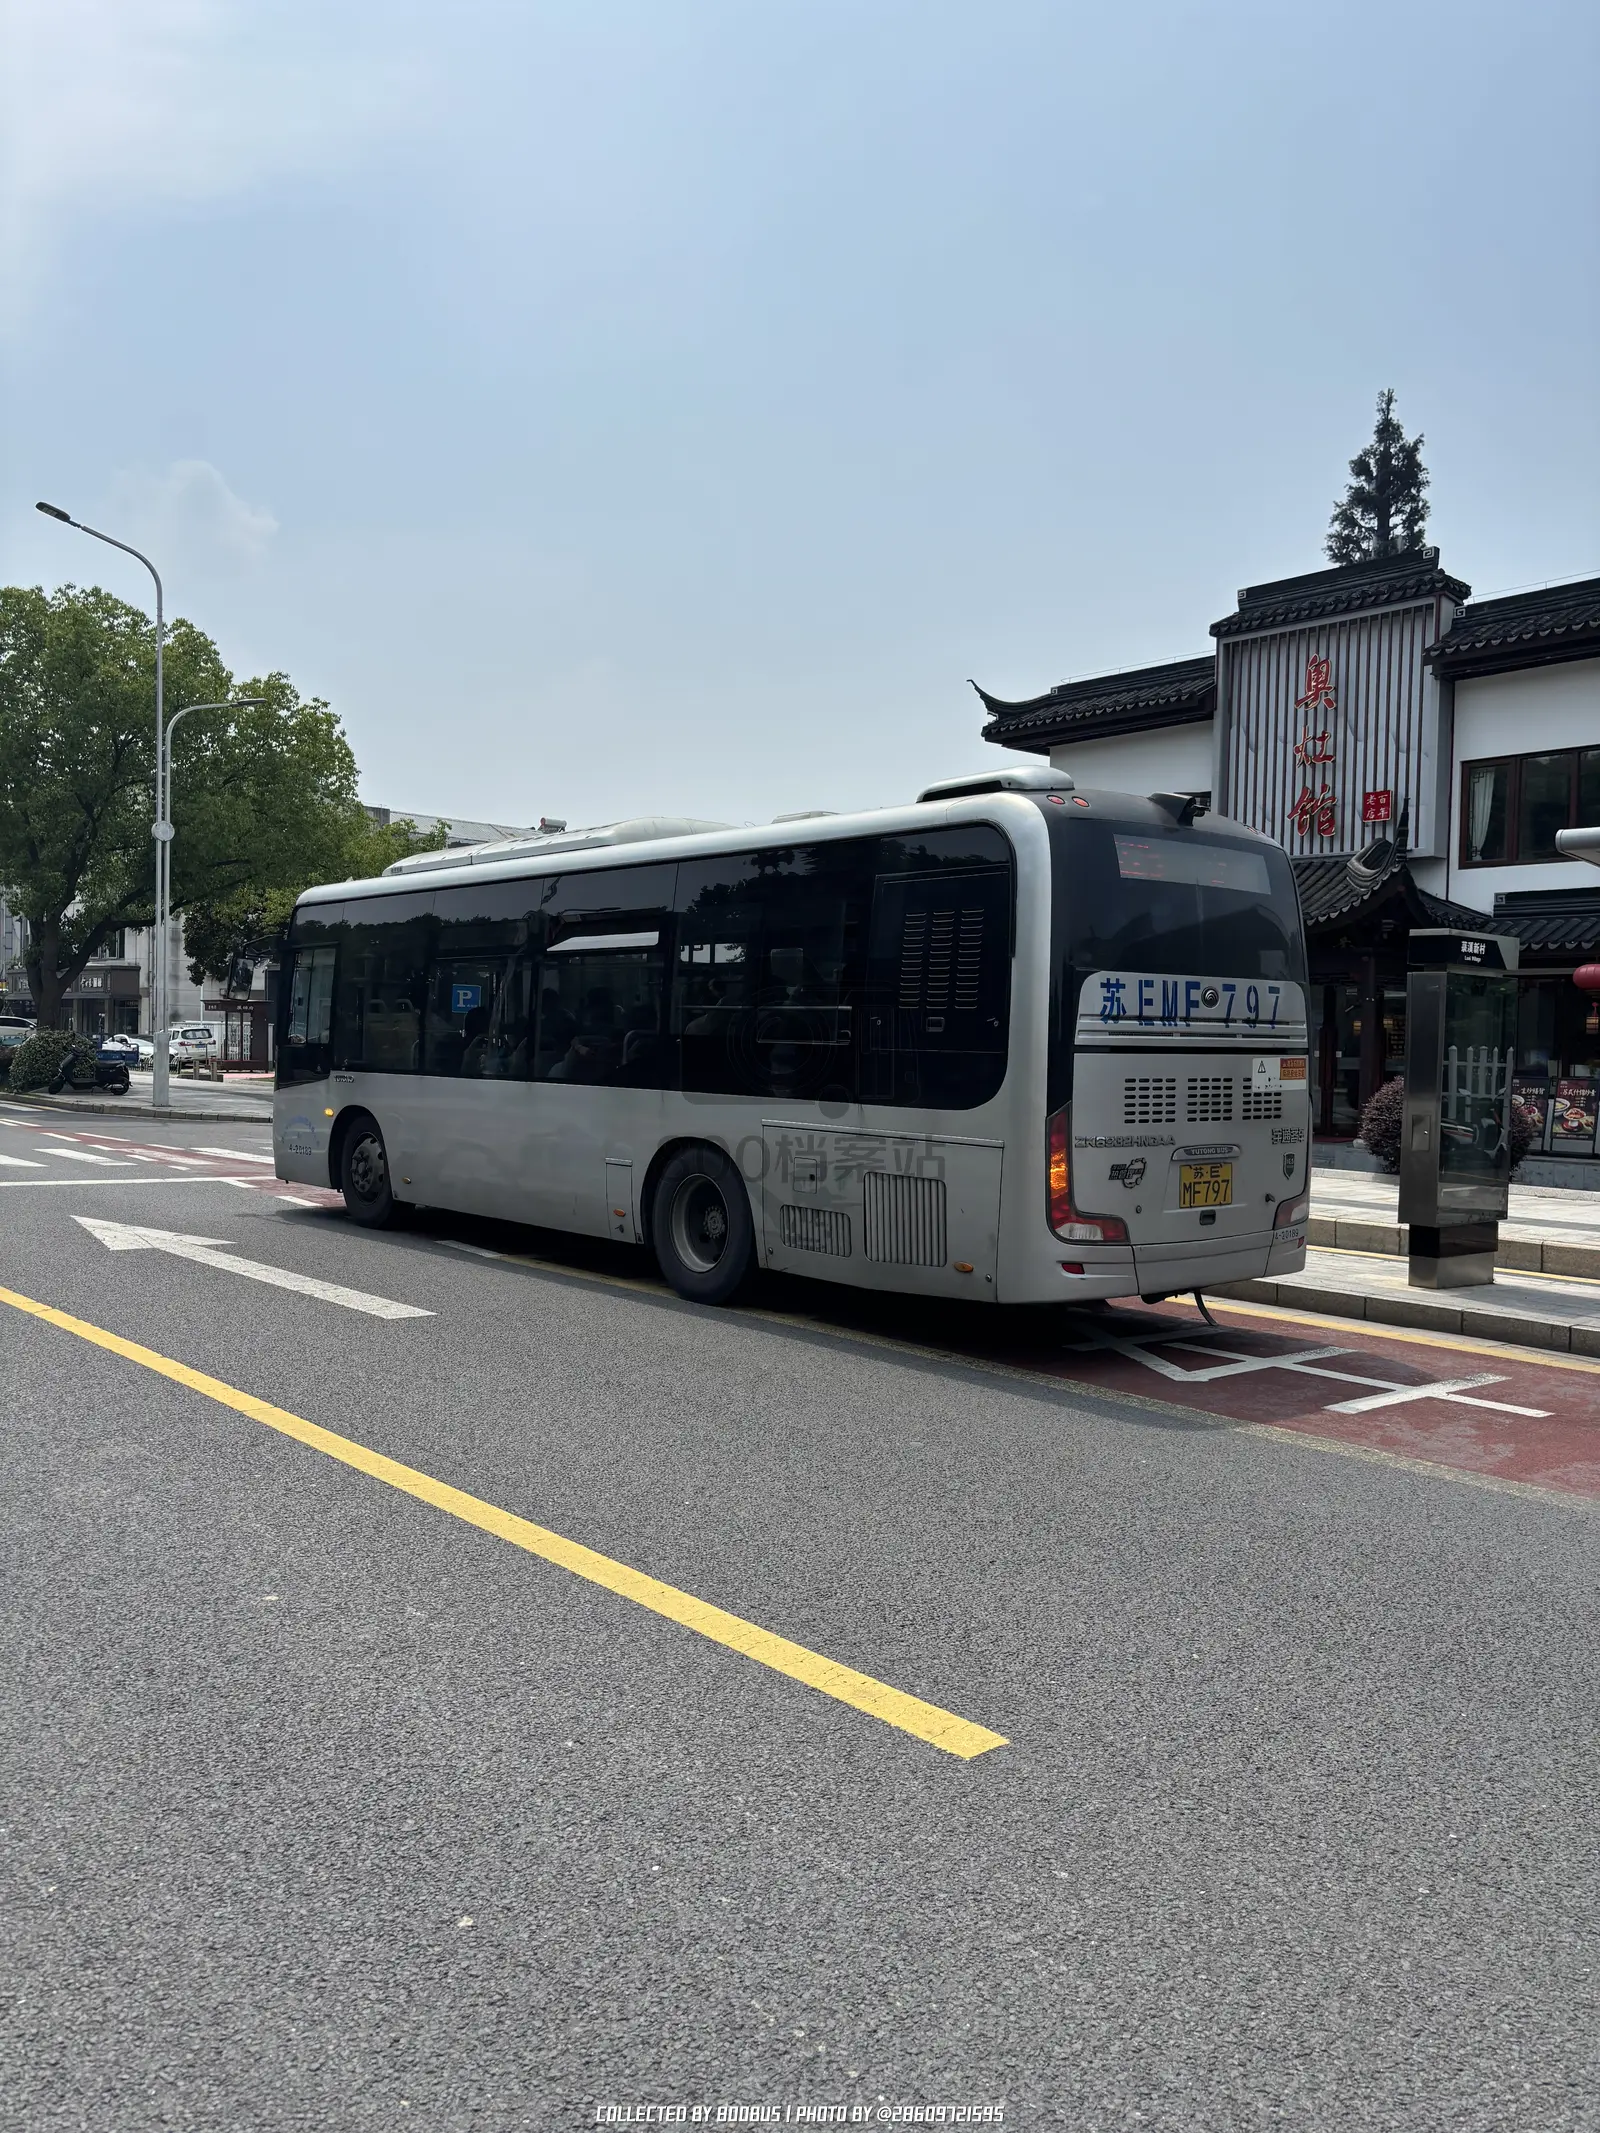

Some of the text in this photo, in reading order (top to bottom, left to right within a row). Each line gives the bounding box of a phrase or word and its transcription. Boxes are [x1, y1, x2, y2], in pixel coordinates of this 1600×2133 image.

[1287, 653, 1338, 837] 奥灶馆
[1365, 795, 1377, 819] 老店
[1377, 794, 1389, 819] 百年
[1191, 1147, 1215, 1155] YUTONG
[1193, 1165, 1221, 1180] 苏·E
[1183, 1180, 1229, 1205] MF797
